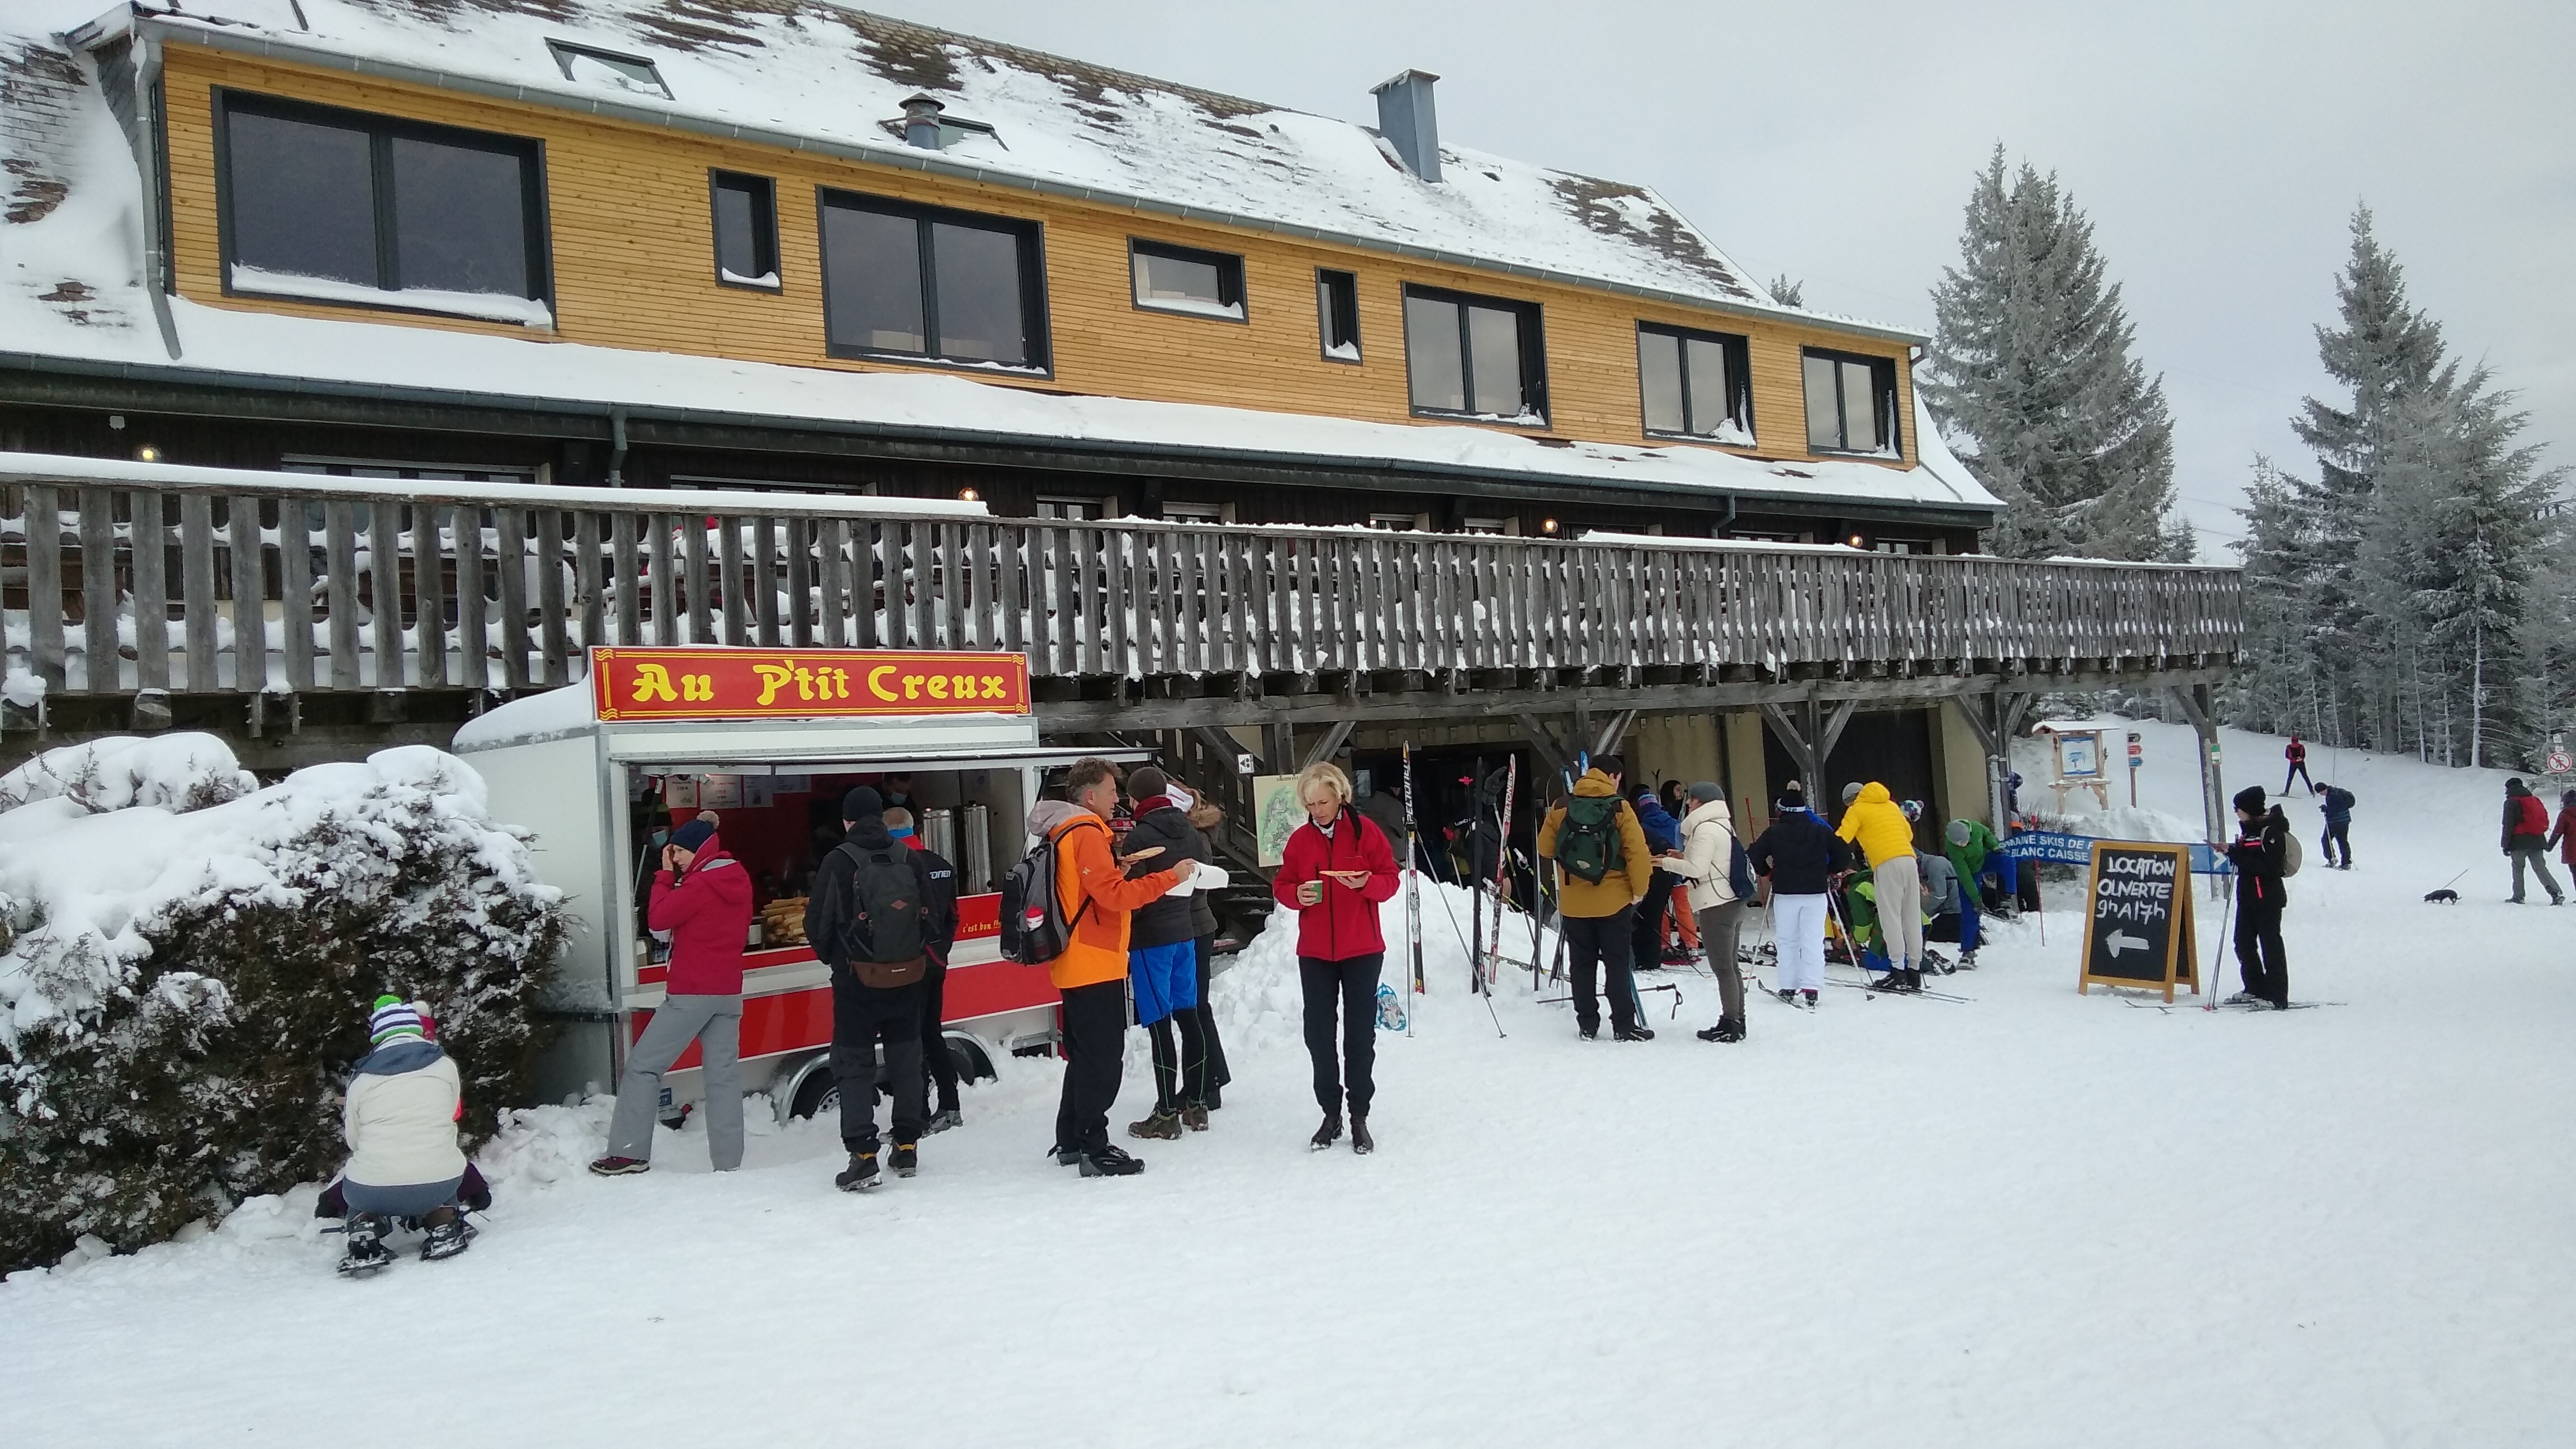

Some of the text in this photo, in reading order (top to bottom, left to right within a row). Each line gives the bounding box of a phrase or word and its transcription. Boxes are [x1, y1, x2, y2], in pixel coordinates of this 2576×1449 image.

[632, 660, 1006, 705] Au P'tit Creux
[1998, 835, 2037, 848] OMAINE
[2039, 836, 2064, 847] SKIS
[2067, 839, 2083, 849] DE
[2011, 846, 2044, 858] BLANC
[2048, 848, 2089, 861] CAISSE
[2097, 878, 2172, 899] OUVERTE
[962, 923, 978, 933] c'est
[979, 922, 992, 931] bon
